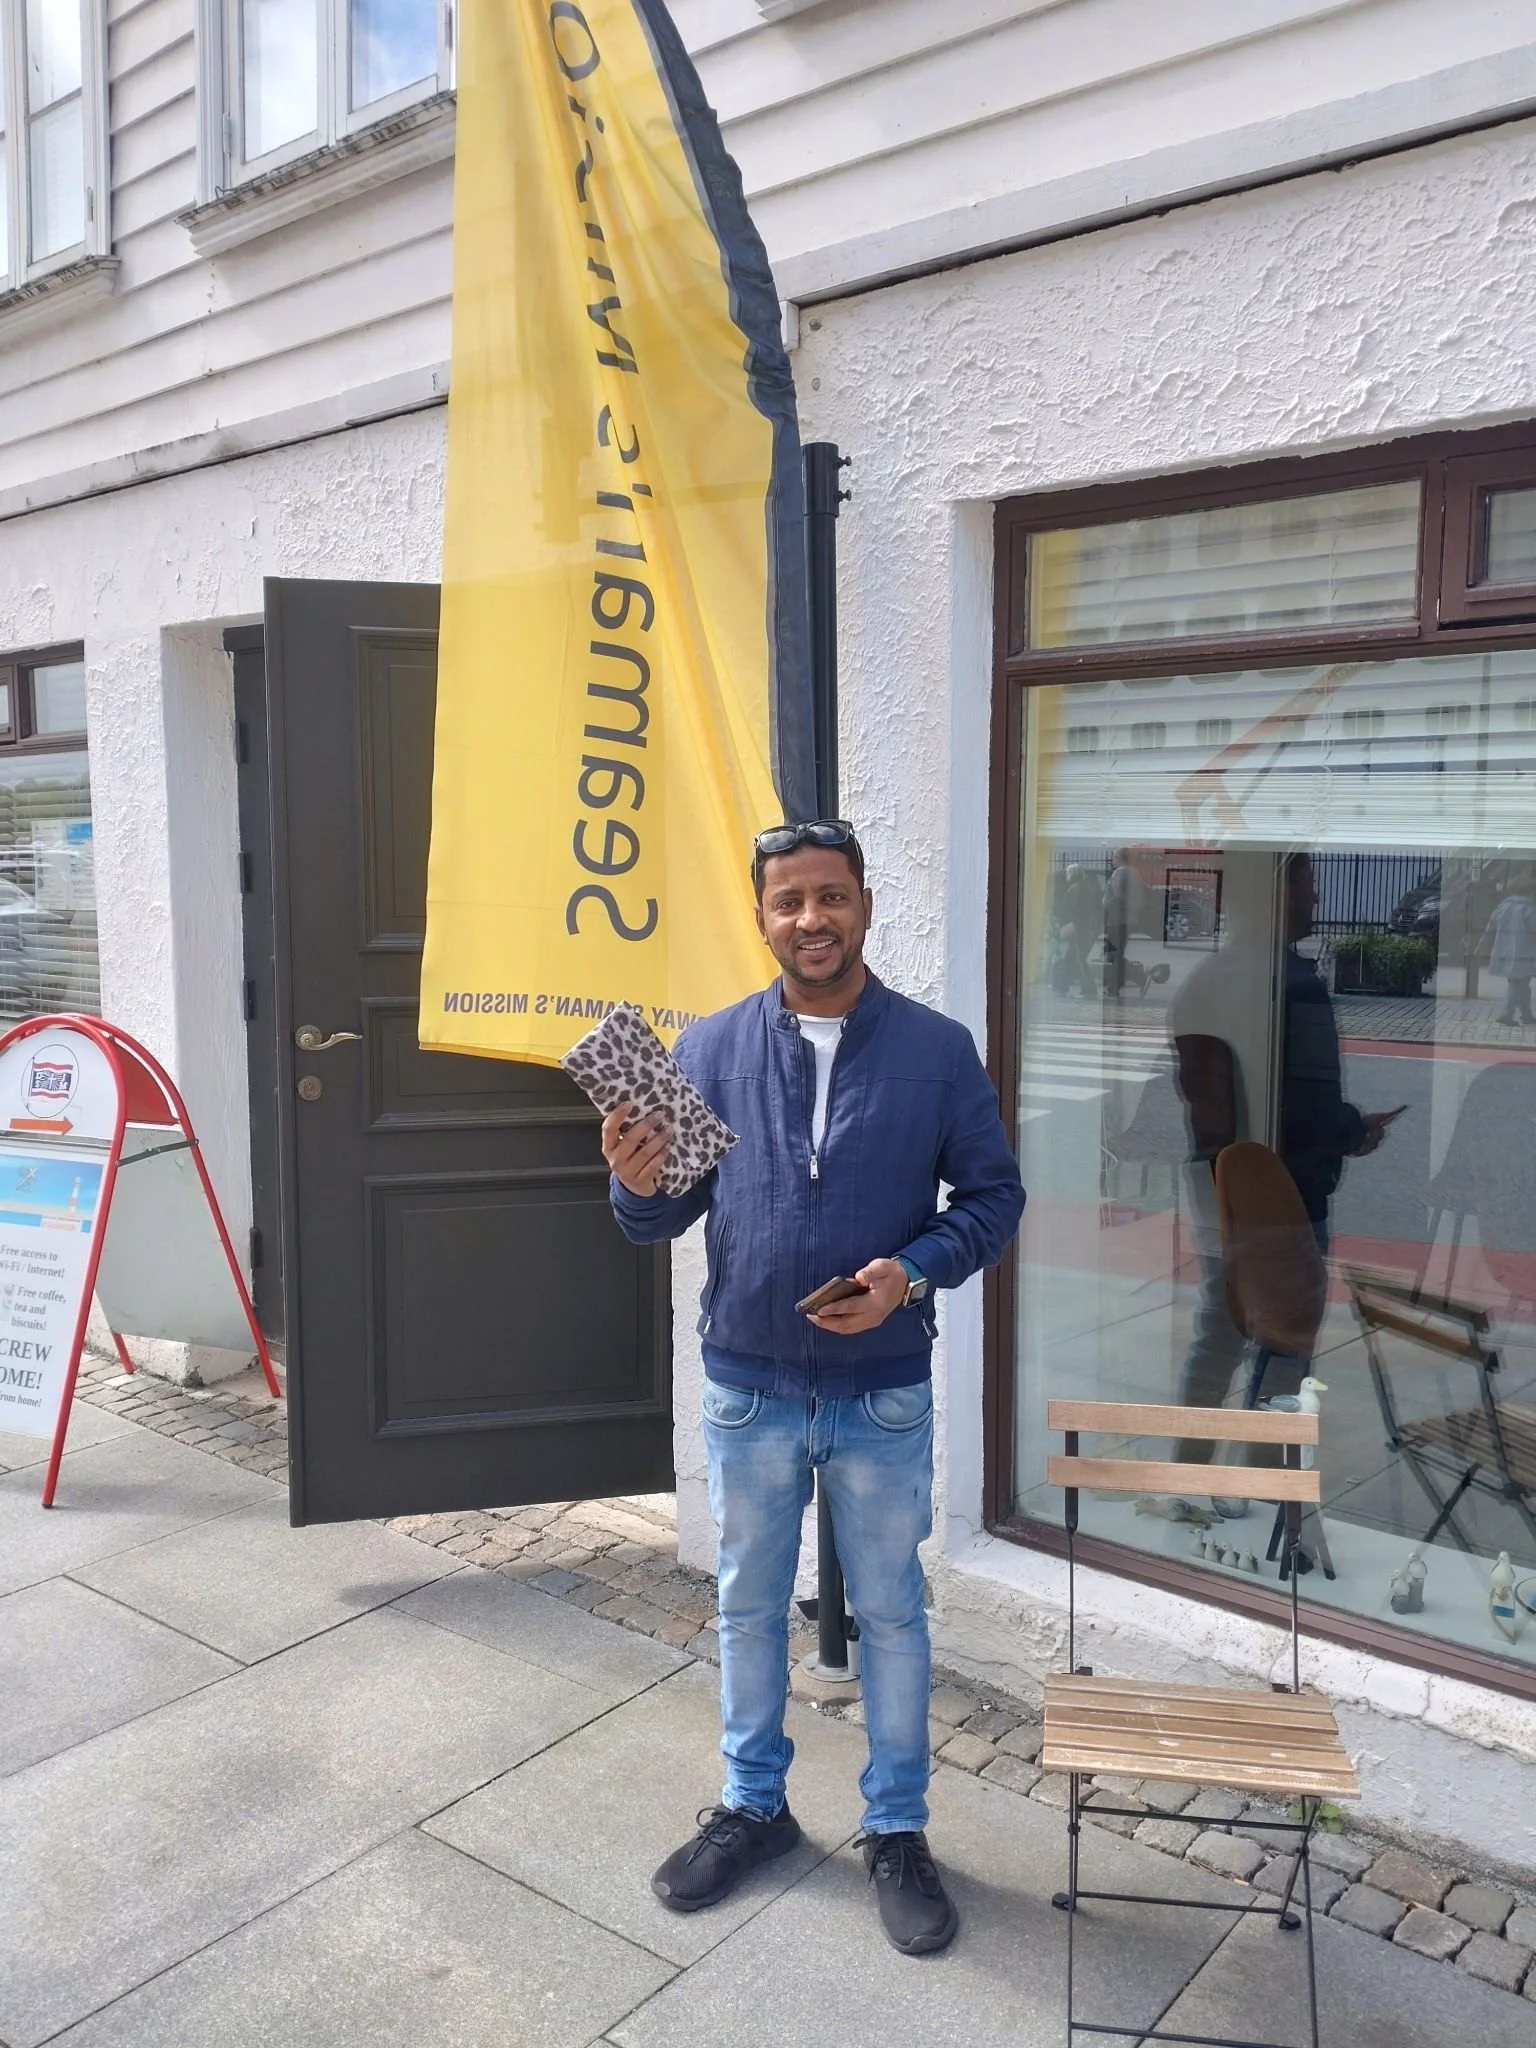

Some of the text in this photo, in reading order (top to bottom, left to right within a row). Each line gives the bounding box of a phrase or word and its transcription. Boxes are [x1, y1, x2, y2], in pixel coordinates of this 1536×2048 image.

[0, 1244, 58, 1261] Free access to
[27, 1263, 65, 1279] Internet!
[17, 1286, 66, 1304] Free coffee,
[14, 1302, 47, 1315] tea and
[11, 1315, 48, 1331] biscuits!
[0, 1337, 53, 1362] CREW
[0, 1391, 42, 1408] rom home!
